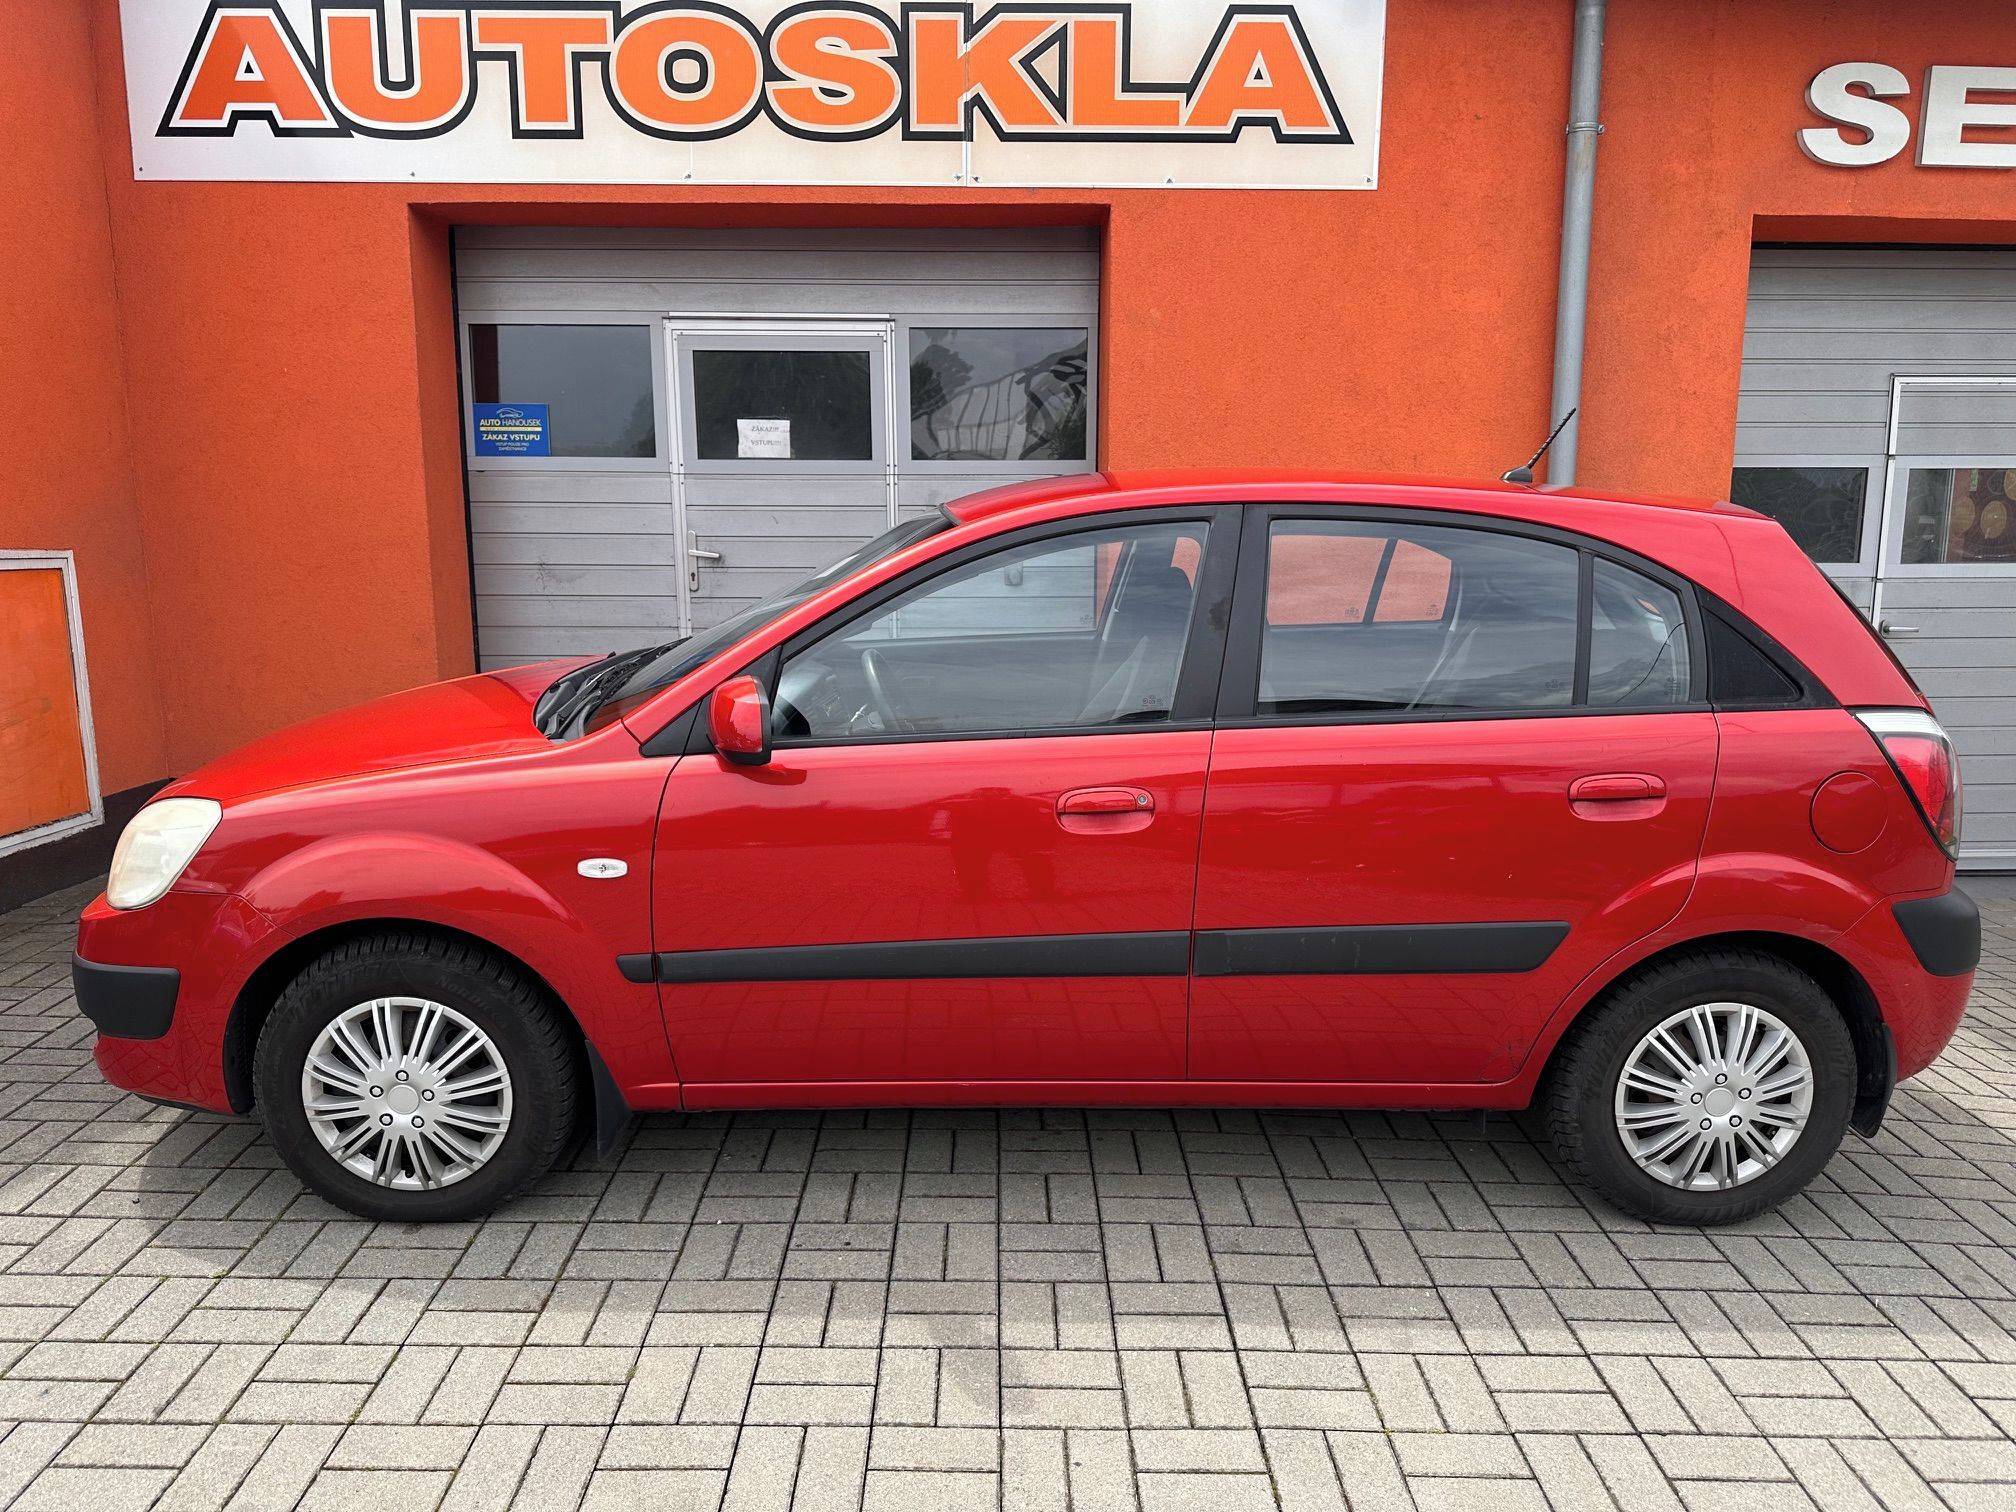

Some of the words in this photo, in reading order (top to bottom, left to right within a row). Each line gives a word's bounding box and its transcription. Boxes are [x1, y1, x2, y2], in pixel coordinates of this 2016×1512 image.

[156, 0, 1354, 144] AUTOSKLA
[1797, 61, 2016, 170] SE
[482, 432, 508, 441] ZÁKAZ
[510, 433, 540, 441] VSTUPU
